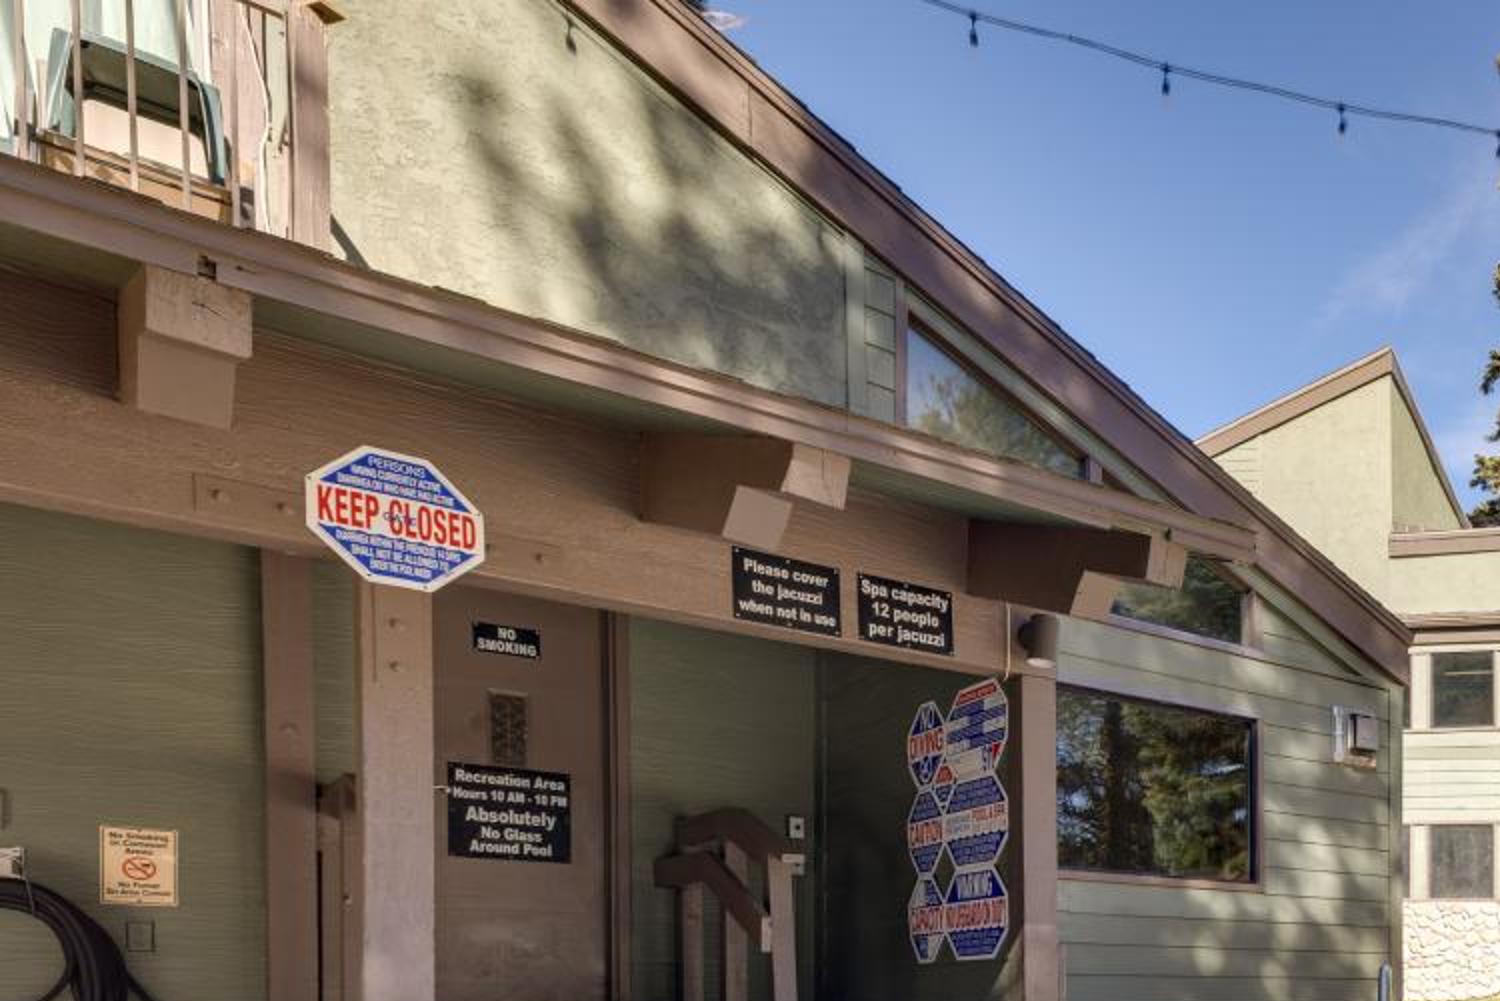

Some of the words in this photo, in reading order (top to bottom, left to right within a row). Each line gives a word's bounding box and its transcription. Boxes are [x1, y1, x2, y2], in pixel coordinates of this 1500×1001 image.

[368, 455, 427, 479] PERSONS
[317, 484, 380, 530] KEEP
[389, 499, 476, 550] CLOSED
[743, 558, 788, 580] Please
[792, 569, 829, 588] cover
[752, 579, 774, 596] the
[777, 585, 823, 606] jacuzzi
[861, 579, 888, 599] Spa
[891, 588, 949, 613] capacity
[739, 600, 774, 617] when
[777, 607, 797, 620] not
[800, 609, 812, 624] in
[814, 615, 836, 628] use
[871, 601, 890, 618] 12
[893, 609, 939, 629] people
[476, 637, 537, 657] SMOKING
[498, 627, 517, 641] NO
[868, 622, 894, 639] per
[897, 626, 945, 648] jacuzzi
[919, 705, 935, 732] NO
[909, 728, 943, 758] DIVING
[455, 768, 530, 789] Recreation
[534, 776, 565, 791] Area
[453, 786, 488, 801] Hours
[507, 792, 525, 804] AM
[550, 796, 568, 808] PM
[465, 805, 557, 832] Absolutely
[480, 825, 501, 840] No
[504, 828, 543, 843] Glass
[470, 839, 519, 856] Around
[523, 842, 553, 858] Pool
[956, 870, 993, 900] WARNING
